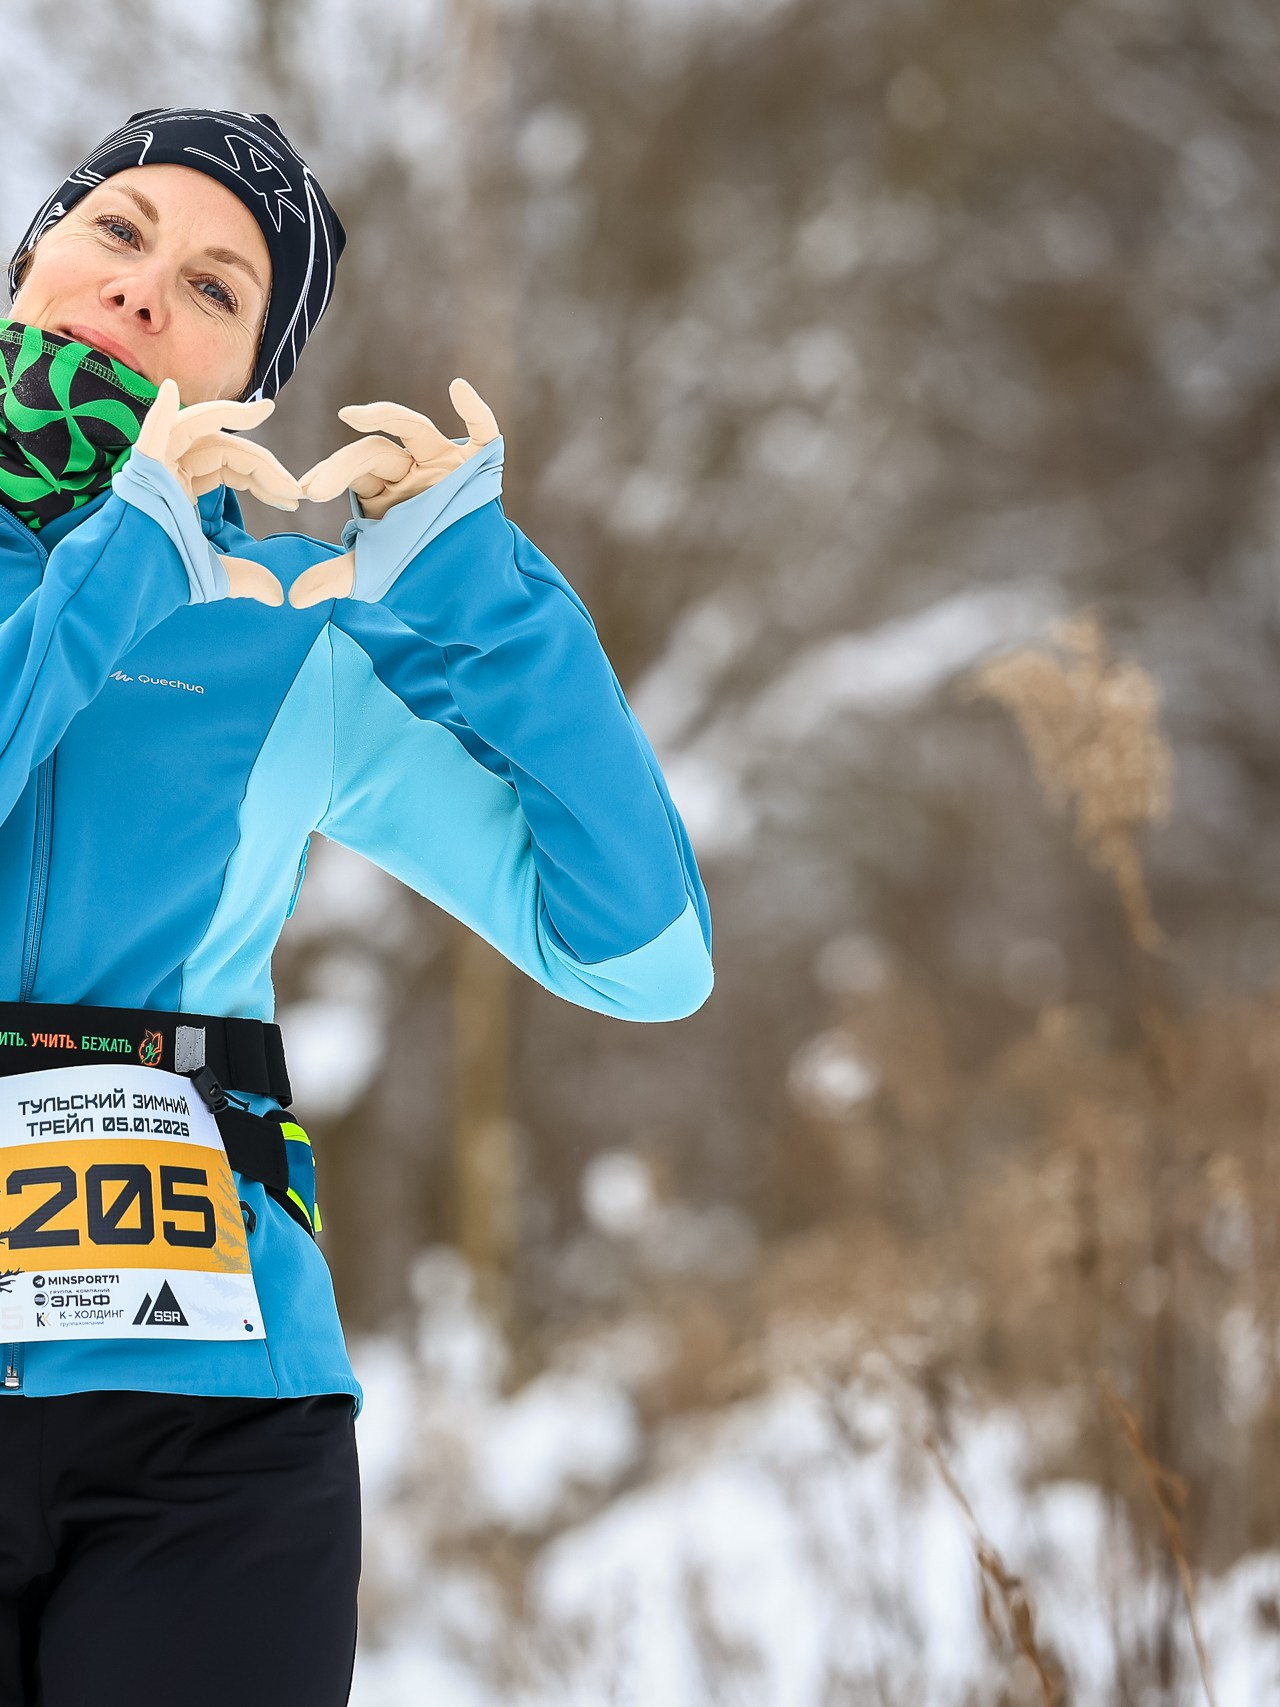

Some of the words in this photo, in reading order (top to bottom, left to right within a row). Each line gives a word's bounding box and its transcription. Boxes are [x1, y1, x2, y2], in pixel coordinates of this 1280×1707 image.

[138, 674, 204, 694] Quechua
[31, 1032, 77, 1050] УЧИТЬ.
[81, 1035, 132, 1053] БЕЖАТЬ
[18, 1088, 125, 1115] ТУЛЬСКИЙ
[132, 1093, 190, 1116] ЗИМНИЙ
[27, 1113, 94, 1137] ТРЕЙЛ
[102, 1117, 190, 1137] 05.01.2026
[6, 1164, 216, 1250] 205
[48, 1275, 120, 1286] MINSPORT71
[50, 1294, 111, 1308] ЭЛЬФ
[154, 1311, 181, 1322] SSR
